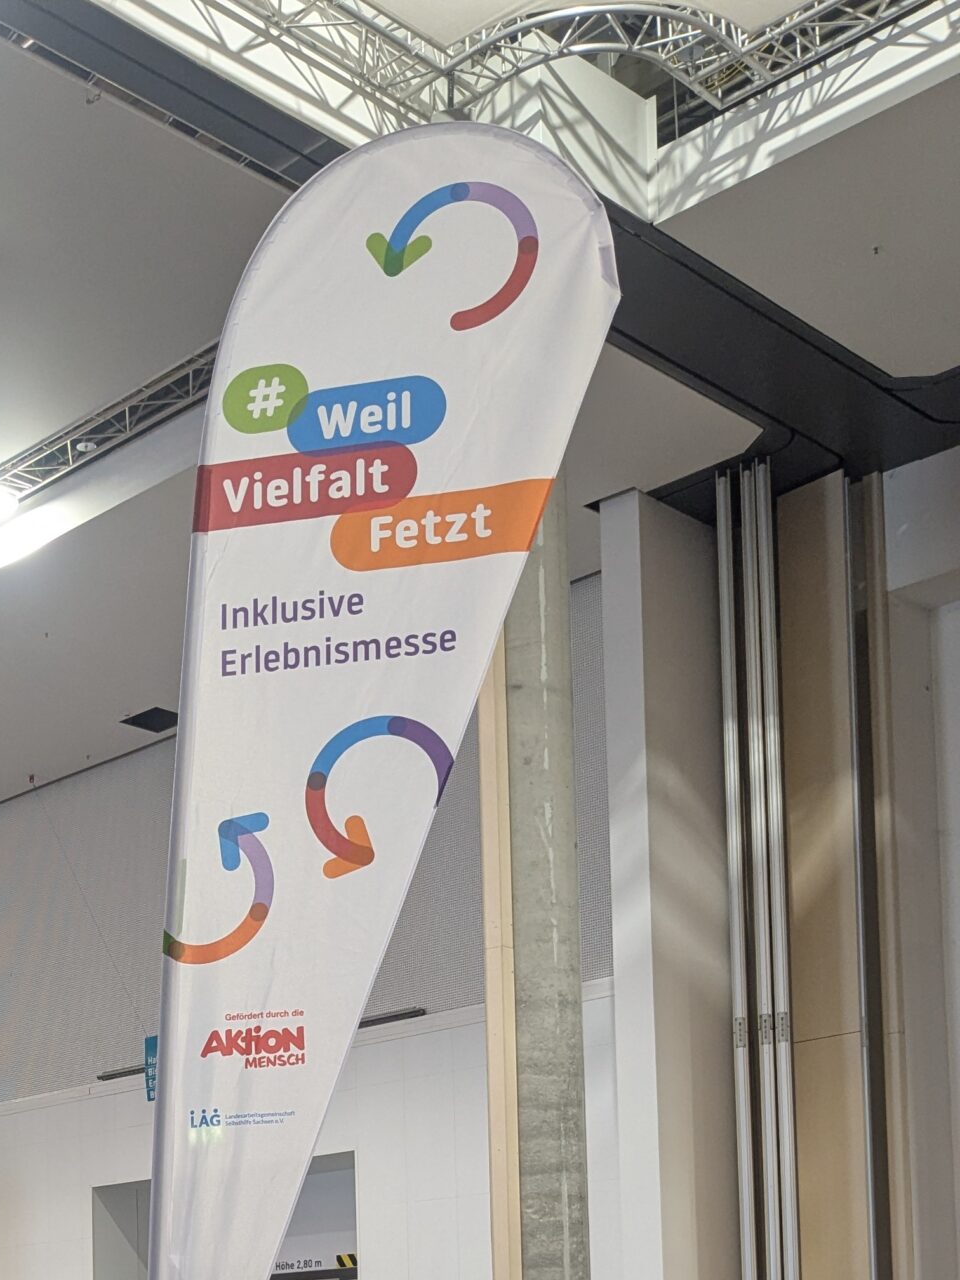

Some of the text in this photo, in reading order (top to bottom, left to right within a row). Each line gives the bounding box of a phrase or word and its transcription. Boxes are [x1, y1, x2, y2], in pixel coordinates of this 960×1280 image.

[246, 377, 411, 439] # Weil
[222, 459, 390, 513] Vielfalt
[370, 504, 493, 552] Fetzt
[221, 589, 365, 630] Inklusive
[221, 629, 458, 676] Erlebnismesse
[225, 1009, 304, 1021] Gefördert durch die
[244, 1053, 305, 1069] MENSCH
[190, 1109, 221, 1128] LAG
[275, 1262, 295, 1271] Höhe
[297, 1259, 313, 1270] 2,80
